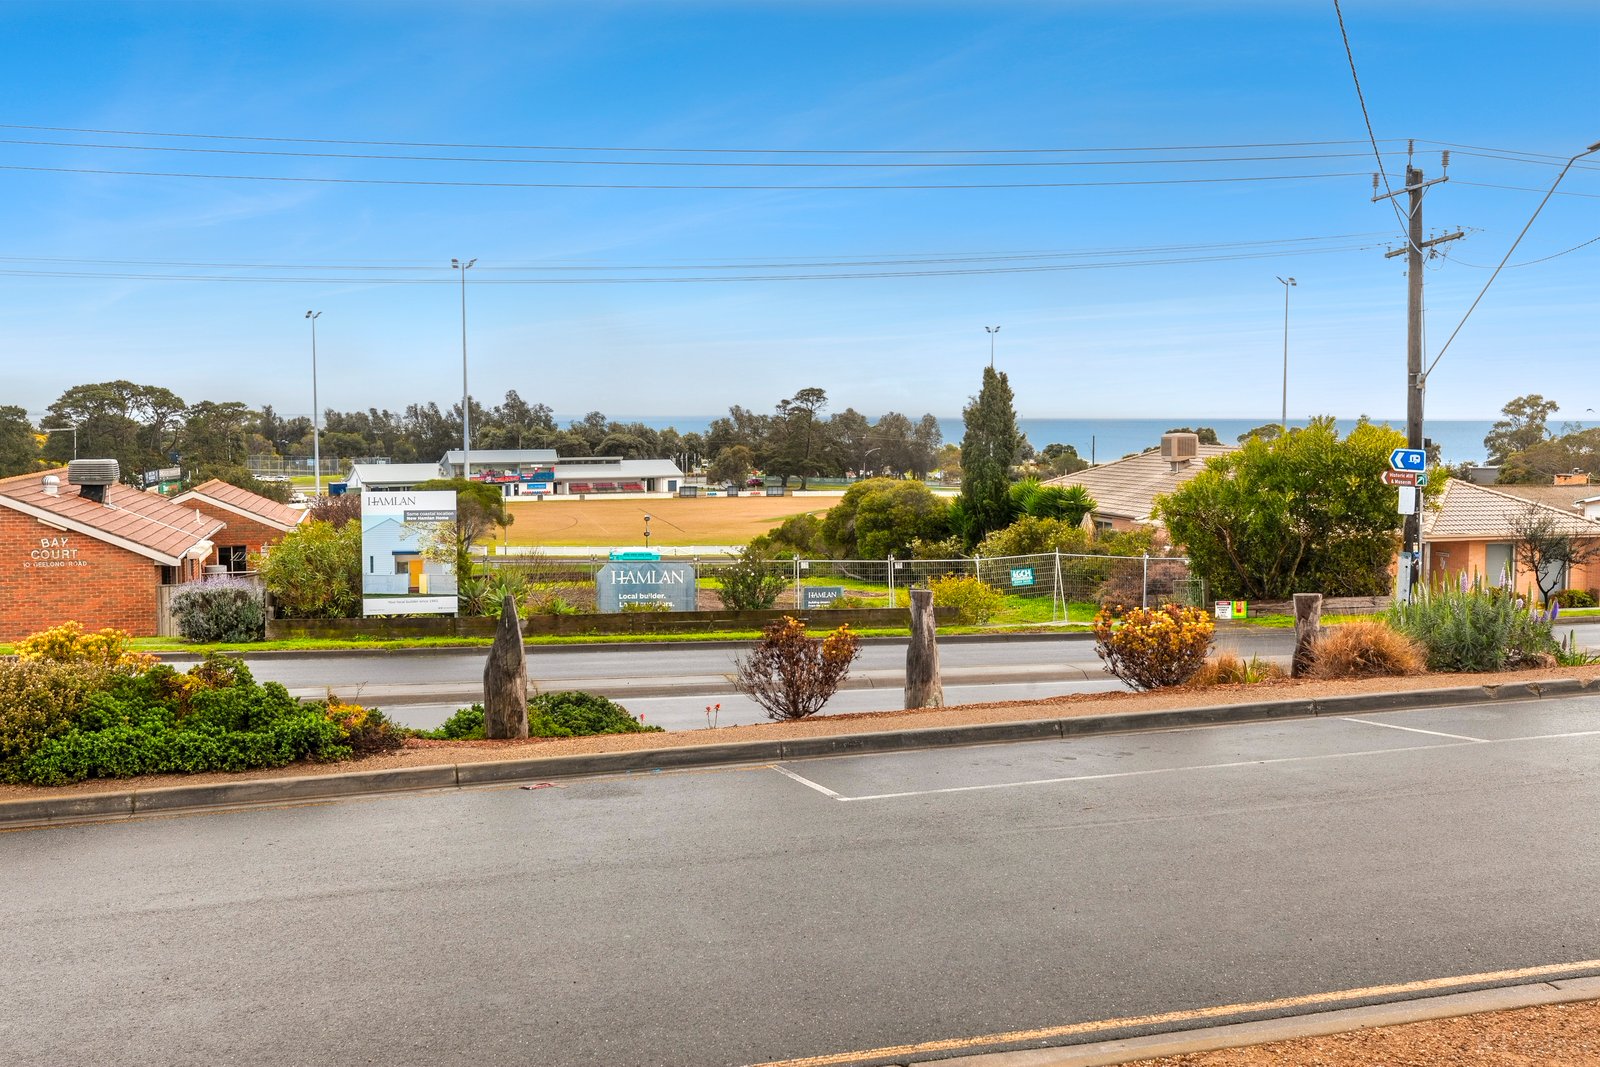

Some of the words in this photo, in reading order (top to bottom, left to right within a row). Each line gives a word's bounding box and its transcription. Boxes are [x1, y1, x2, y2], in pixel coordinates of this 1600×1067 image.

[367, 496, 416, 506] HAMLAN
[41, 537, 68, 548] BAY
[31, 549, 77, 560] COURT
[611, 570, 685, 584] HAMLAN
[618, 592, 638, 600] Local
[639, 592, 667, 600] builder.
